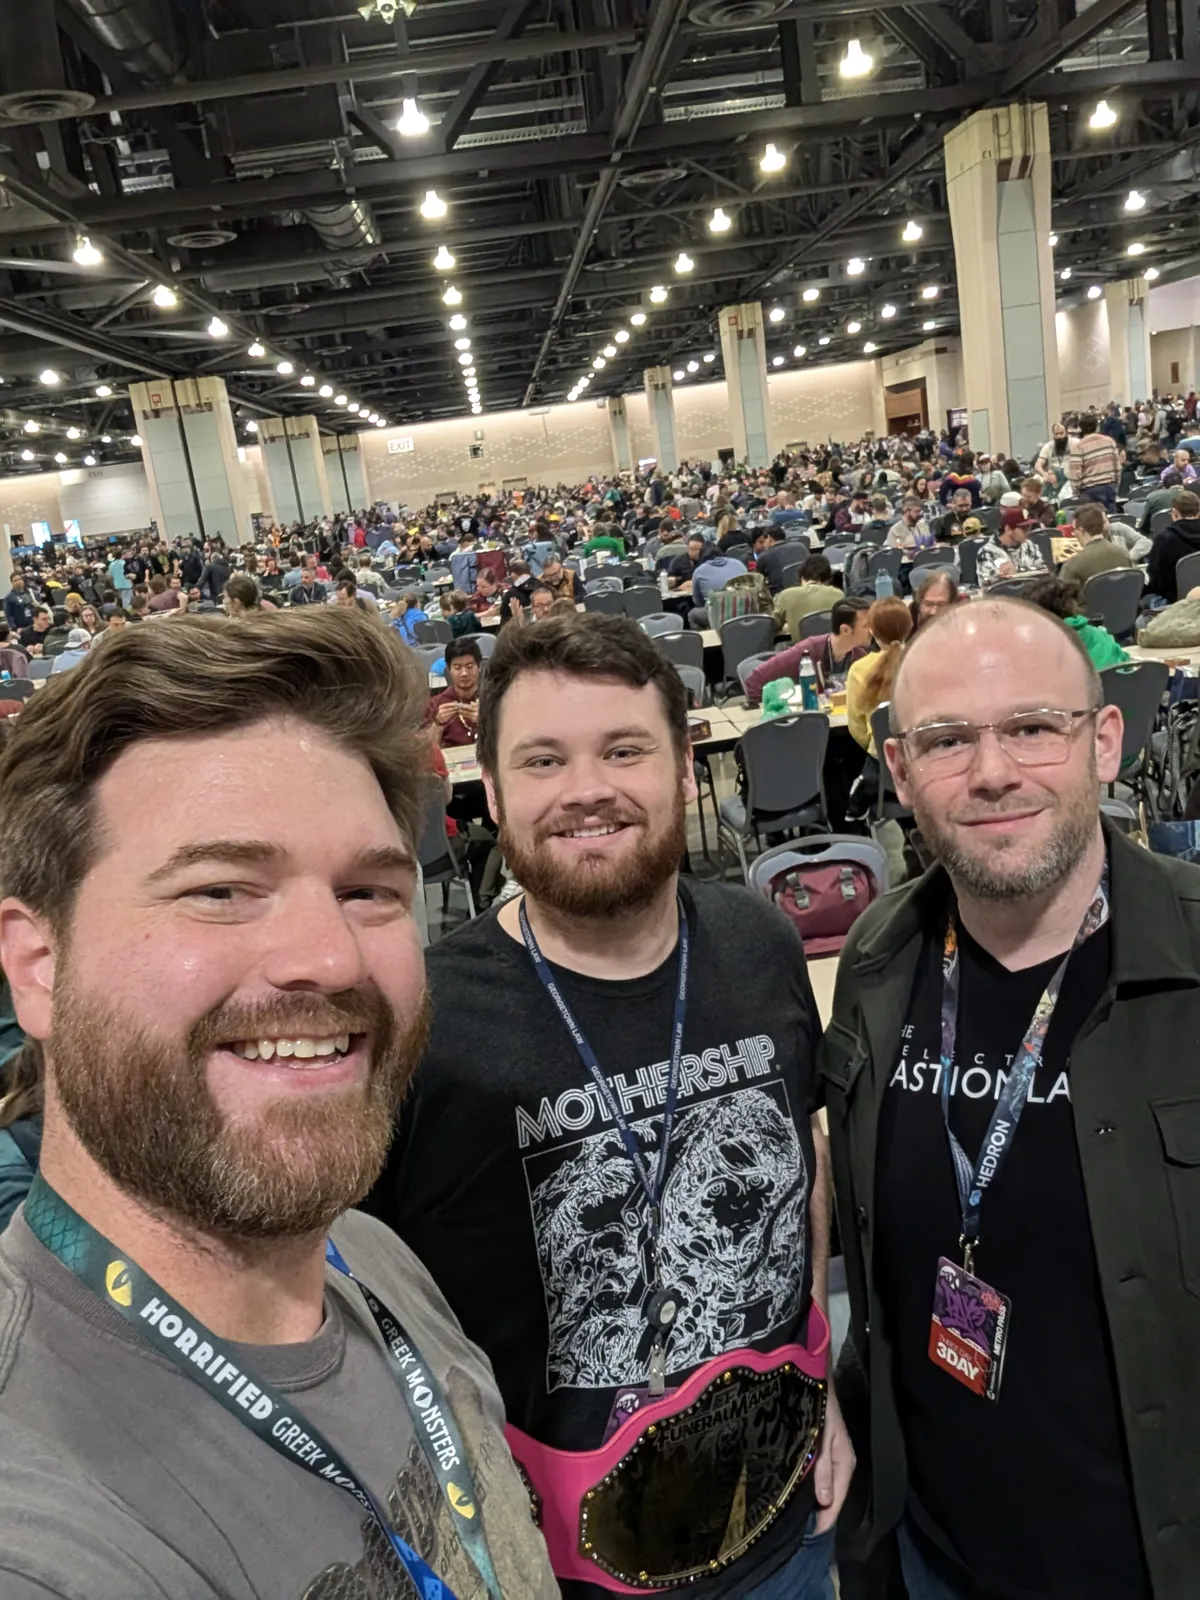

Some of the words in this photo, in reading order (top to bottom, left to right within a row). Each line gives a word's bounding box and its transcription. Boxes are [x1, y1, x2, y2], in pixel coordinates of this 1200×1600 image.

[389, 440, 411, 452] EXIT
[530, 949, 542, 963] LAW
[679, 953, 688, 1001] GEORGETOWN
[547, 982, 575, 1030] GEORGETOWN
[571, 1025, 584, 1045] LAW
[515, 1034, 776, 1149] MOTHERSHIP
[670, 1037, 681, 1090] GEORGETOWN
[590, 1065, 620, 1116] GEORGETOWN
[615, 1113, 628, 1131] LAW
[975, 1118, 1012, 1188] HEDRON
[139, 1297, 273, 1420] HORRIFIED
[271, 1417, 327, 1467] GREEK
[936, 1341, 980, 1381] 3DAY
[381, 1318, 417, 1370] GREEK
[405, 1367, 460, 1472] MONSTERS
